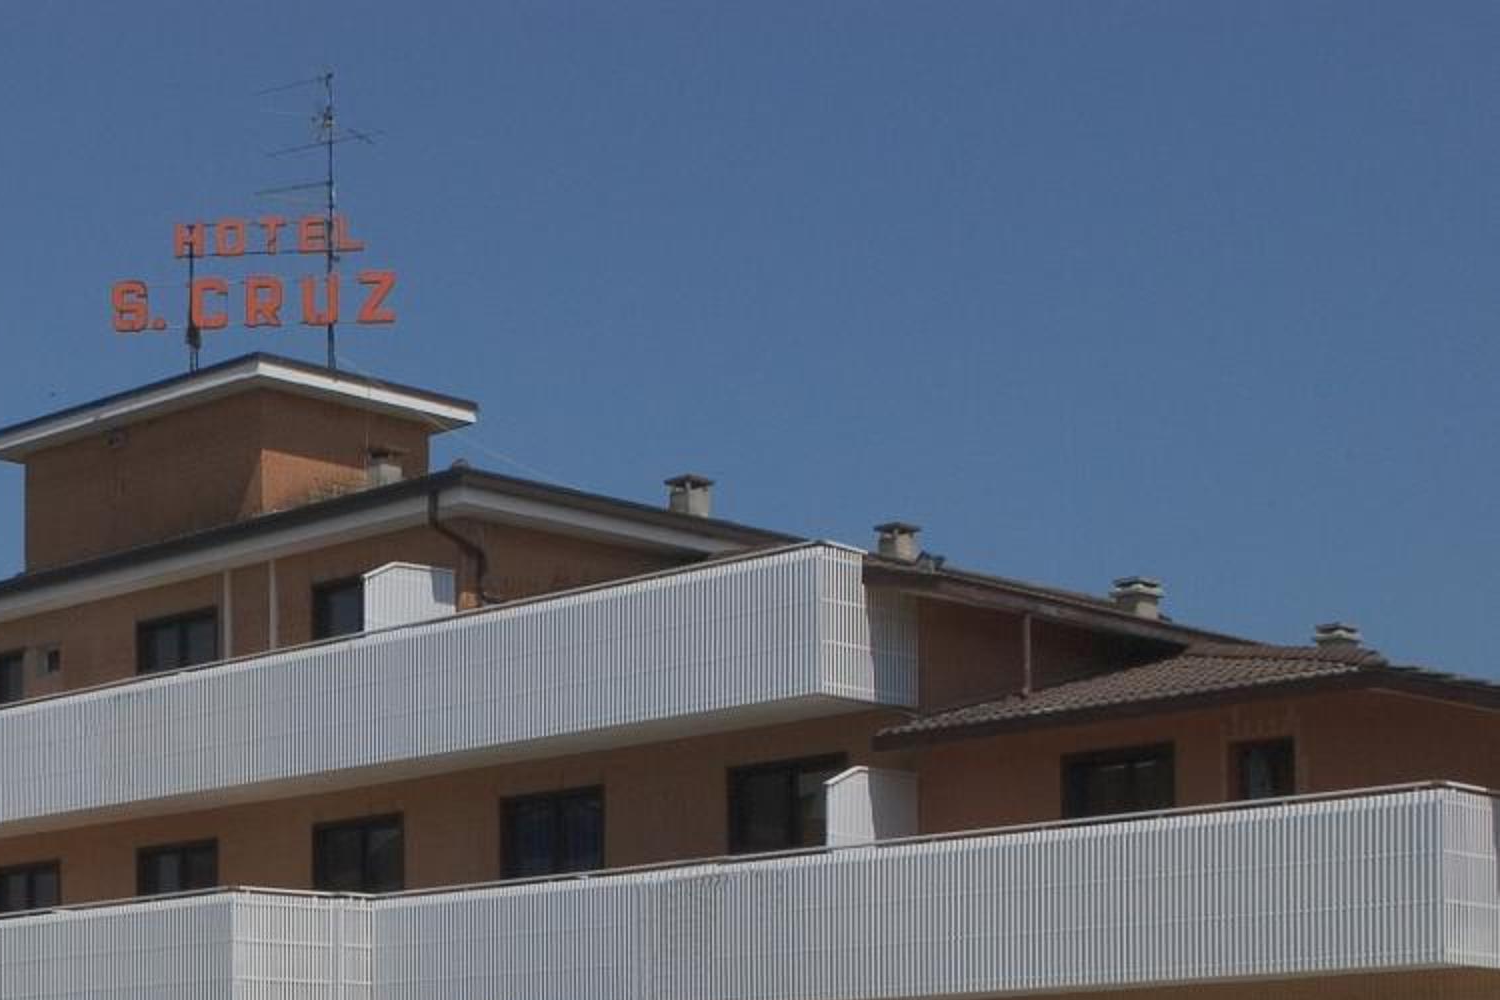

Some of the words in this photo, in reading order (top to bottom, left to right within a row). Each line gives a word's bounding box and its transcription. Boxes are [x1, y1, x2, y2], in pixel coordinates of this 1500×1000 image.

[172, 213, 366, 258] HOTEL
[111, 279, 167, 333] S.
[190, 269, 398, 330] CRUZ
